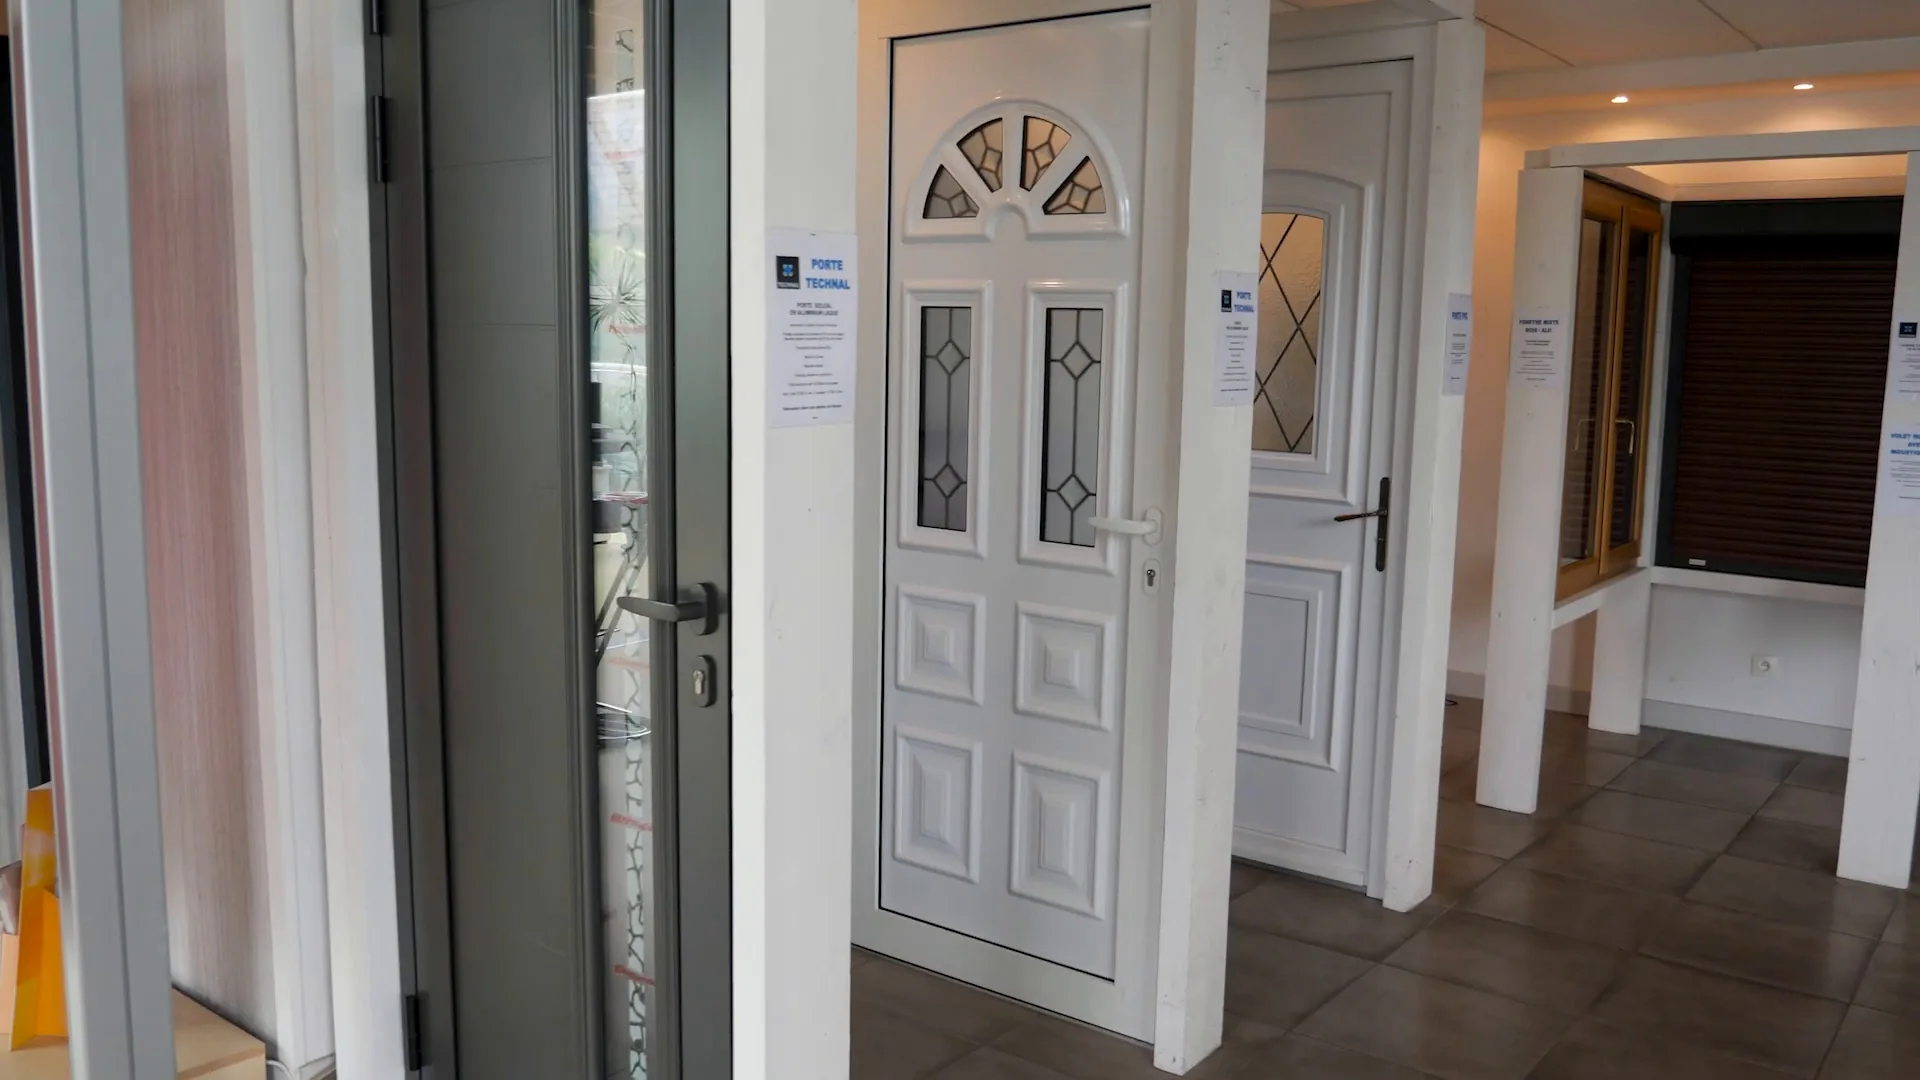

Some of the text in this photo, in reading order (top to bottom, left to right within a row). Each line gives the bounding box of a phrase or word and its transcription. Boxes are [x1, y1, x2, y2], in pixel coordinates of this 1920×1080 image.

[811, 258, 843, 270] PORTE
[805, 277, 850, 289] TECHNAL
[1236, 291, 1251, 300] PORTE
